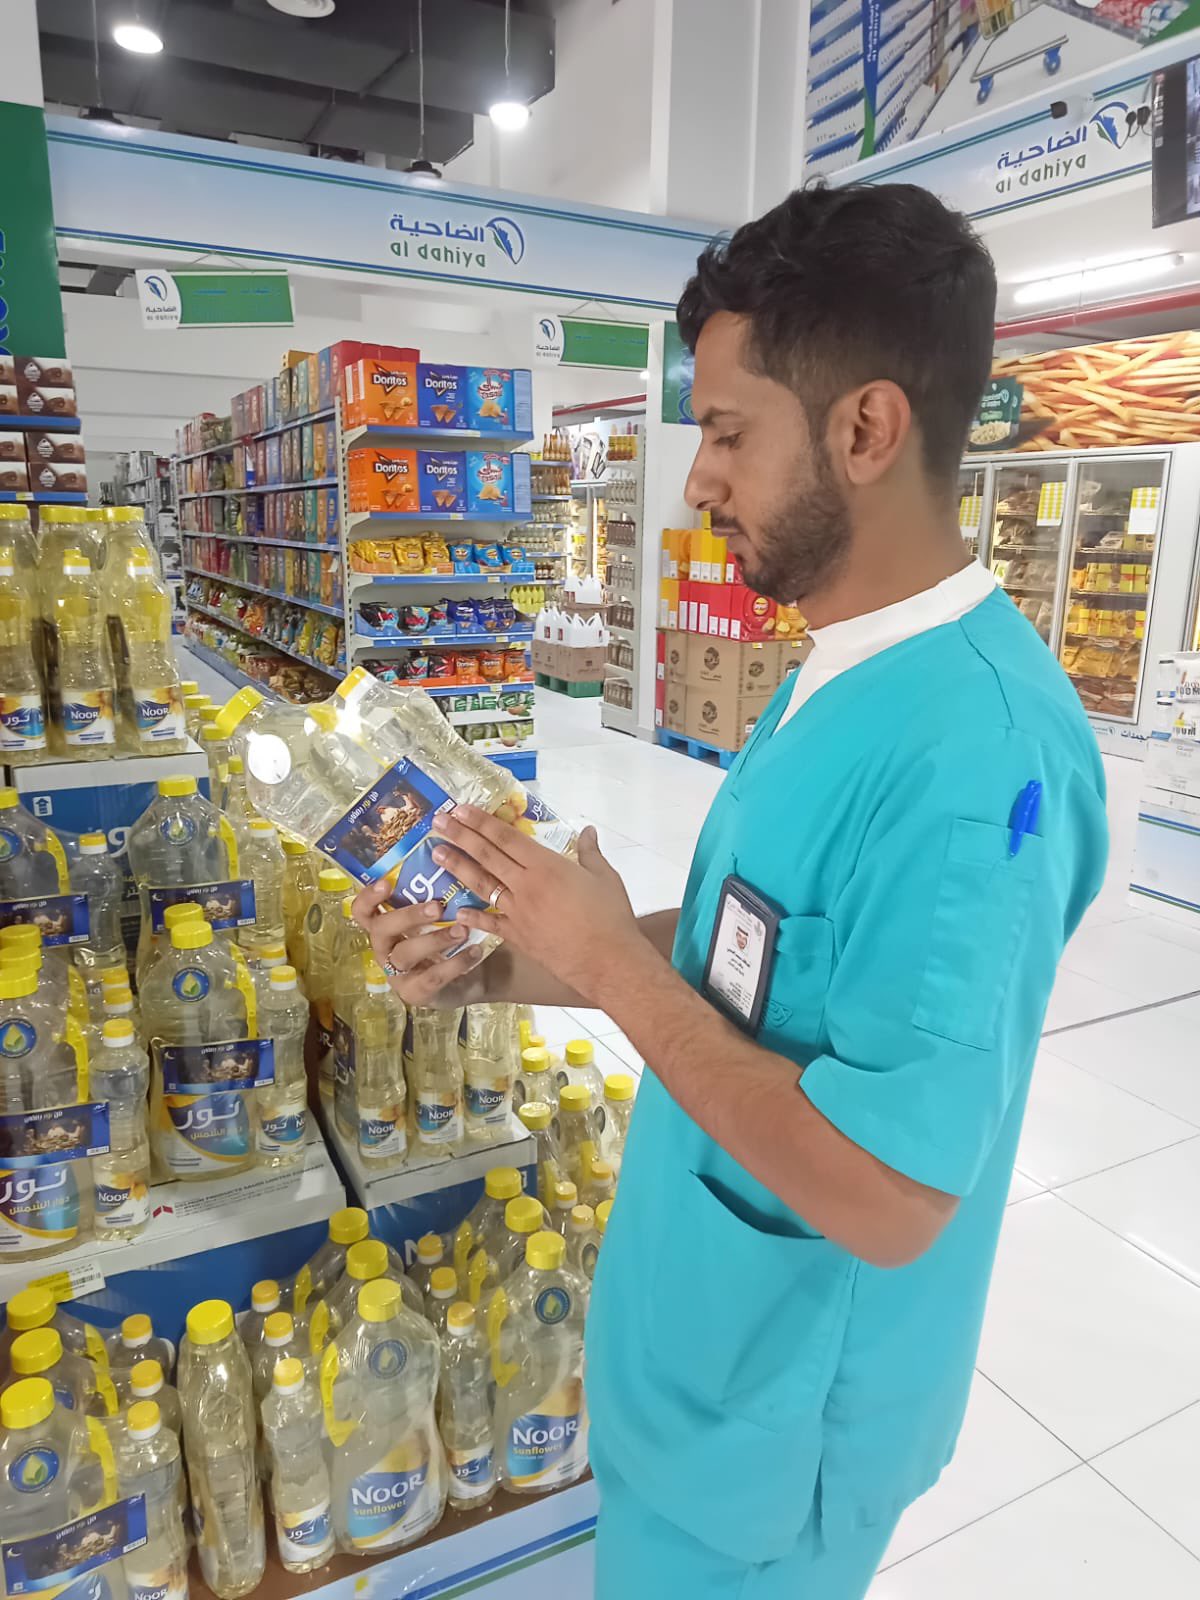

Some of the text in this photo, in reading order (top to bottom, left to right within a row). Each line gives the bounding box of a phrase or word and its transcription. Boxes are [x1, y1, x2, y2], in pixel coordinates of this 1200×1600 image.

[997, 125, 1088, 169] الضاحية
[995, 154, 1086, 193] al dahiya
[390, 214, 485, 242] الضاحية
[390, 240, 486, 268] al dahiya
[373, 374, 407, 386] Doritos
[425, 377, 458, 390] Doritos
[375, 462, 408, 474] Doritos
[426, 463, 458, 475] Doritos
[71, 710, 98, 720] NOOR
[142, 707, 169, 717] NOOR
[6, 714, 30, 726] نور
[175, 1101, 240, 1130] نور
[263, 1118, 287, 1132] نور
[190, 1127, 226, 1141] الشمس
[0, 1168, 67, 1203] نور
[98, 1191, 129, 1202] NOOR
[9, 1199, 50, 1215] الشمس
[513, 1420, 578, 1445] NOOR
[513, 1443, 562, 1456] Sunflower
[351, 1473, 425, 1506] NOOR
[353, 1500, 407, 1516] Sunflower
[288, 1519, 314, 1540] نور
